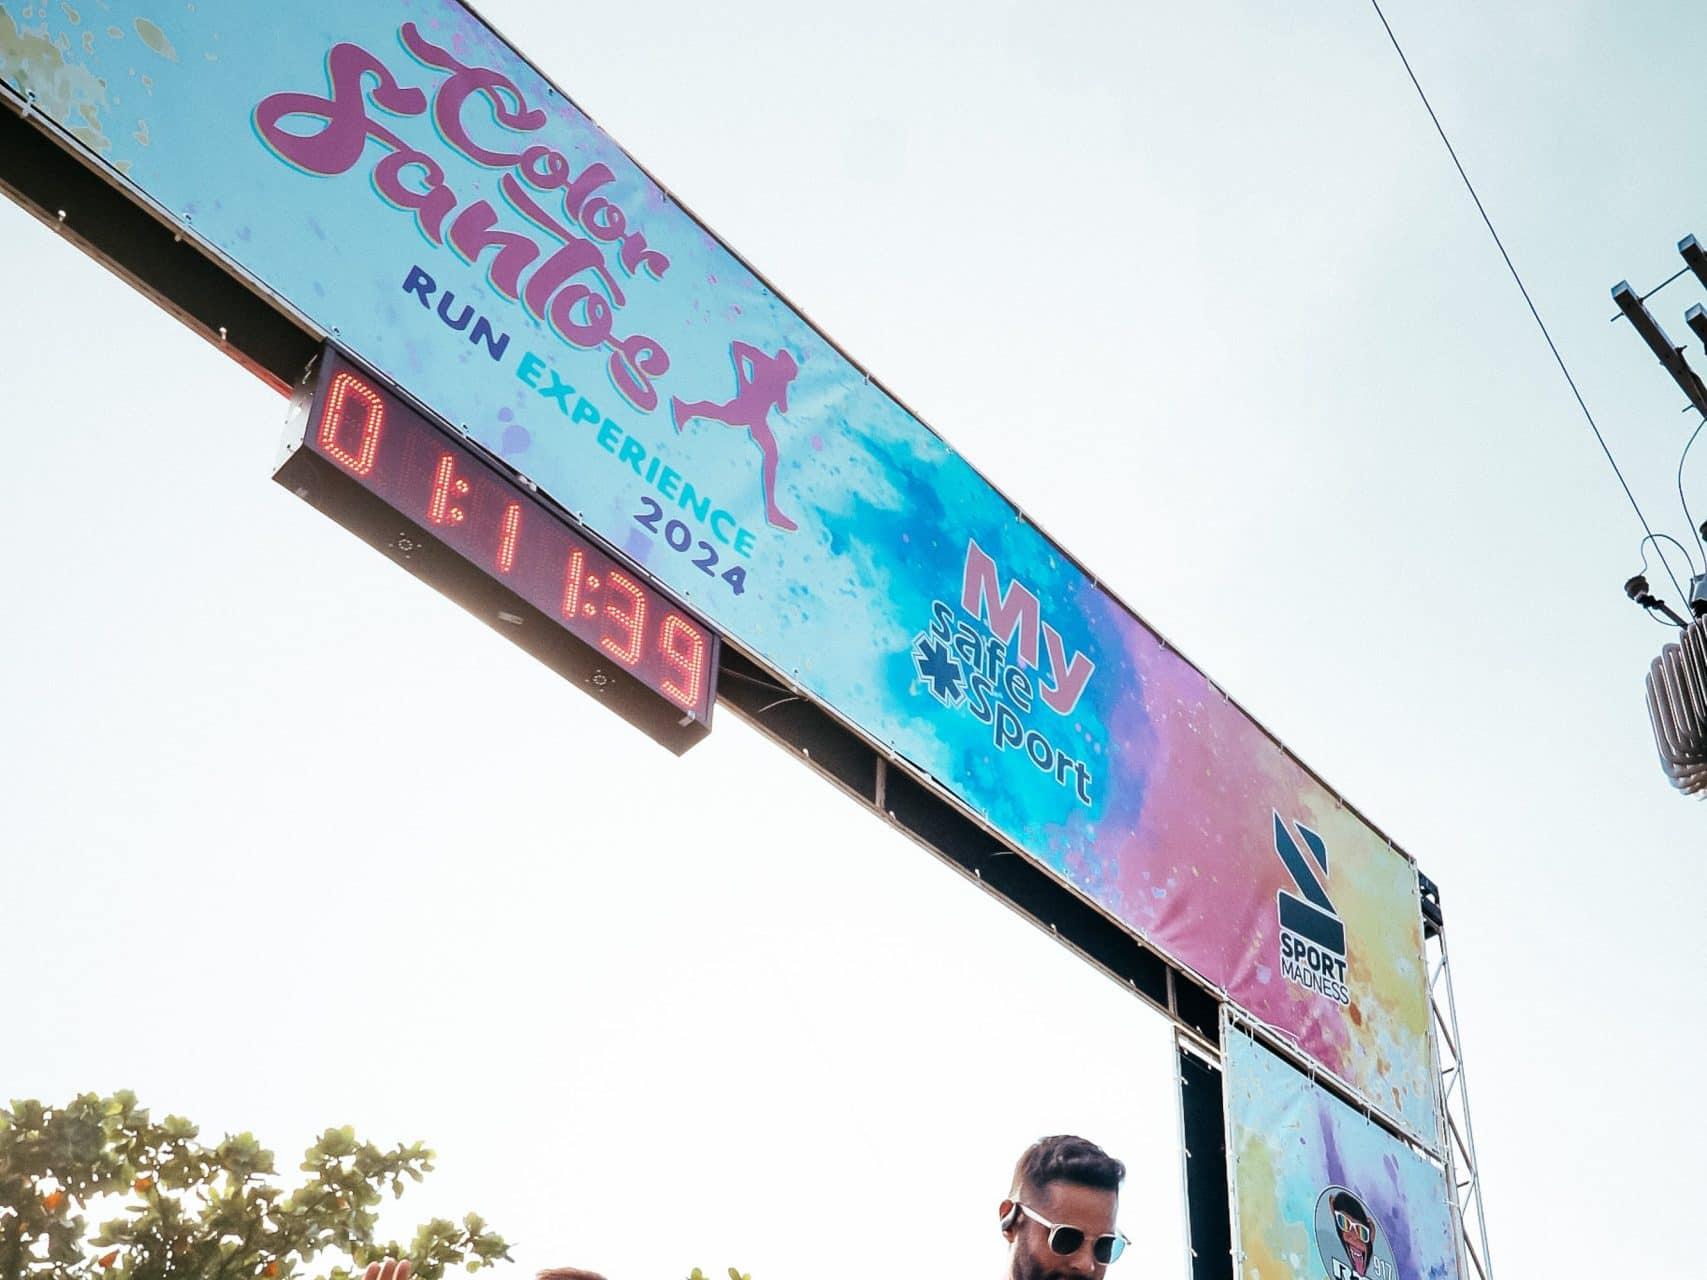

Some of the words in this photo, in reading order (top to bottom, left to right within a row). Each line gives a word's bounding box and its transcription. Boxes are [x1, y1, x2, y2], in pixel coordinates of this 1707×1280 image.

[398, 22, 670, 281] Color
[251, 42, 671, 415] Santos
[402, 265, 510, 362] RUN
[515, 352, 756, 558] EXPERIENCE
[633, 495, 748, 596] 2024
[929, 600, 1033, 712] safe
[961, 538, 1095, 716] My
[1280, 932, 1346, 984] SPORT
[1281, 958, 1349, 1005] MADNESS
